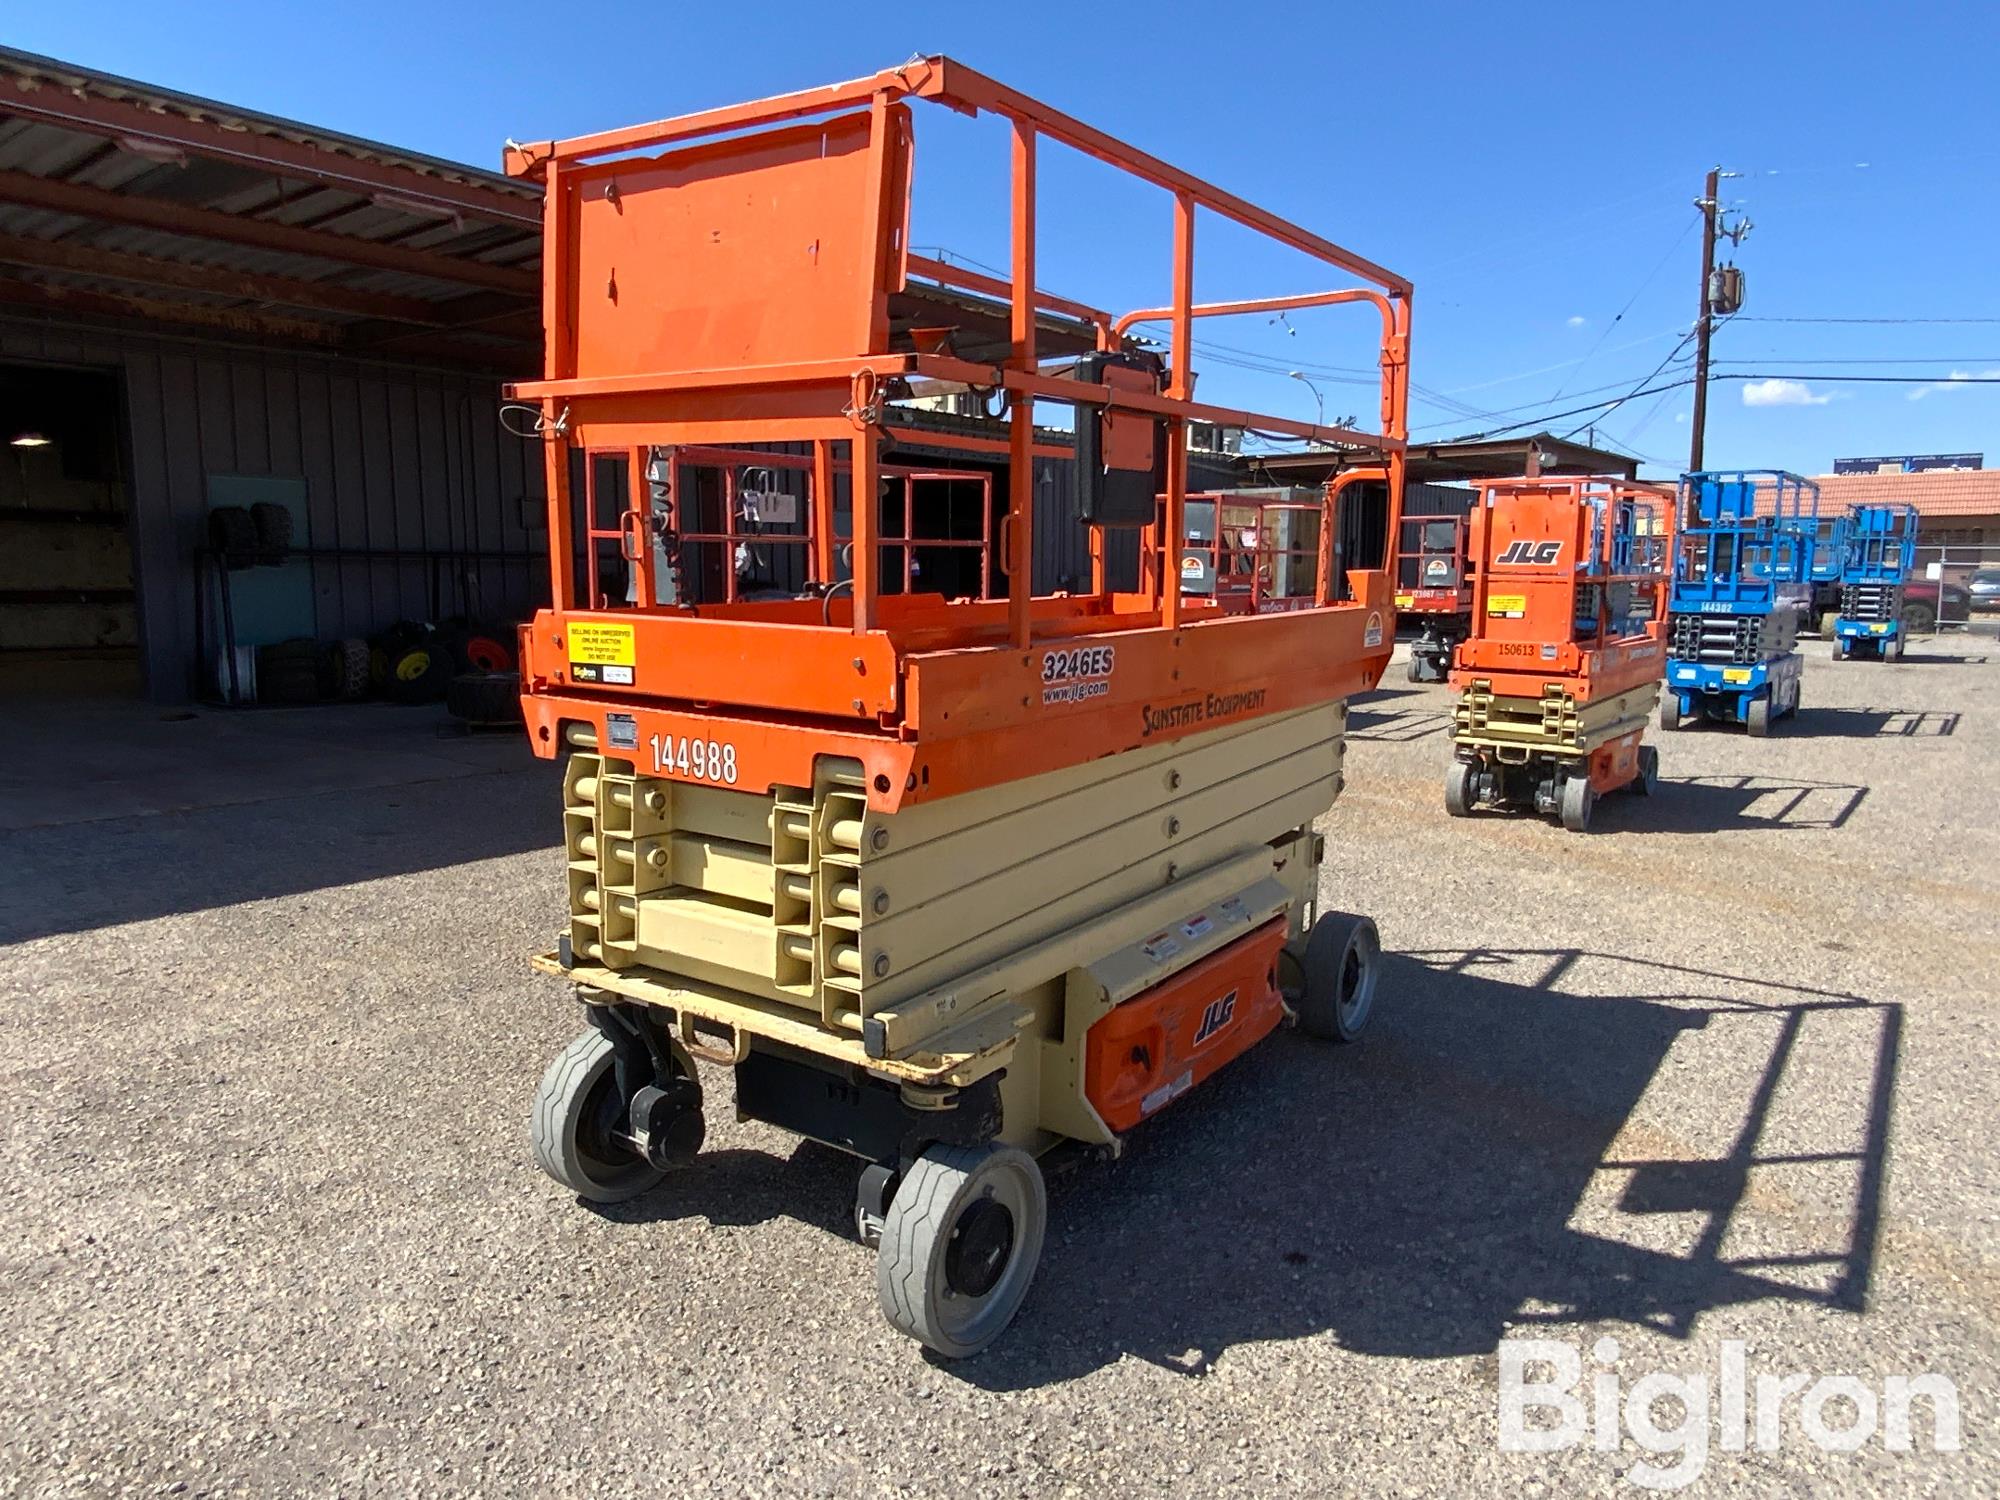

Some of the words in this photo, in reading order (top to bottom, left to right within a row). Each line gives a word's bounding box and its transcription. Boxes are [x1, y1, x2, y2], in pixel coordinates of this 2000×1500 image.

[1495, 541, 1563, 565] JLG
[1499, 644, 1535, 656] 150613
[1043, 648, 1114, 682] 3246ES
[1043, 682, 1108, 703] www.jlg.com
[650, 733, 738, 784] 144988
[1193, 987, 1239, 1047] JLG
